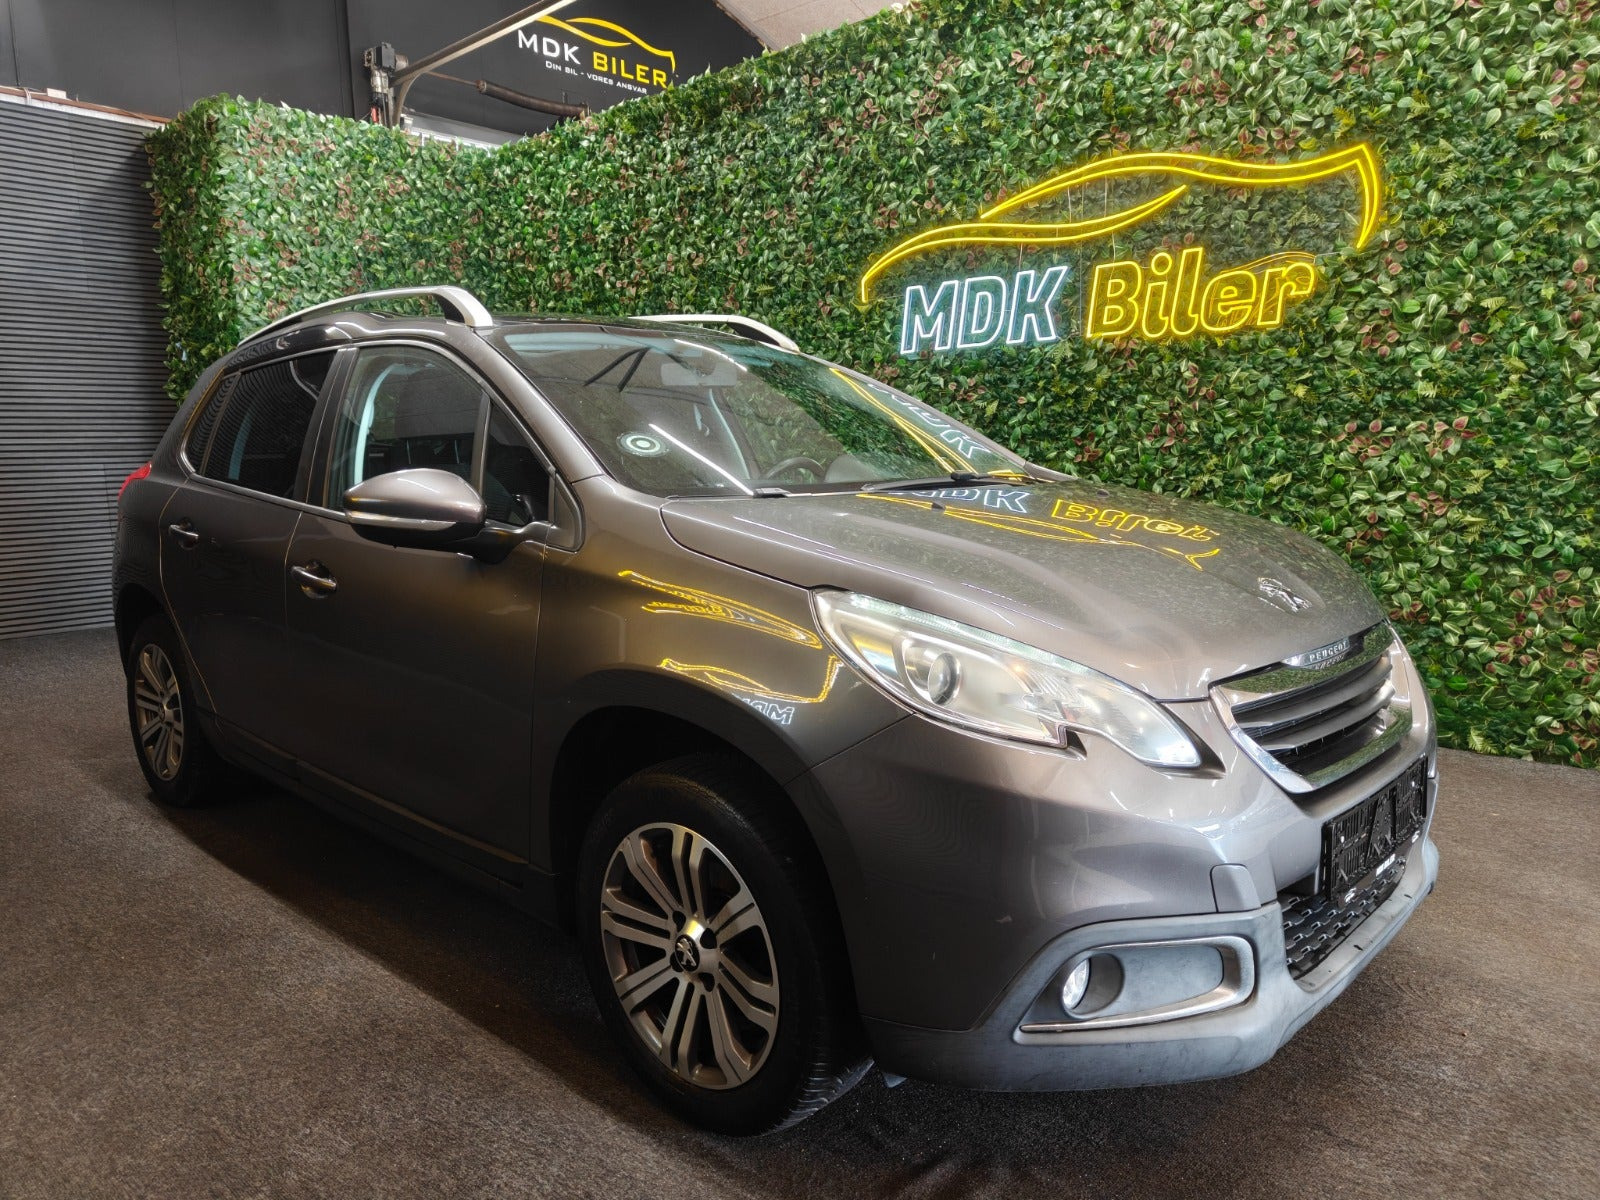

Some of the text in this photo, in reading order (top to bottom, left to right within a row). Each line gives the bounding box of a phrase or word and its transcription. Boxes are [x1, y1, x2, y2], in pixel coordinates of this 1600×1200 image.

[517, 29, 668, 89] MDK BILER
[564, 66, 578, 76] BIL
[586, 72, 614, 86] VORES
[616, 81, 648, 95] ANSVAR
[900, 246, 1316, 355] MDK Biler
[1309, 640, 1348, 663] PEUGEOT
